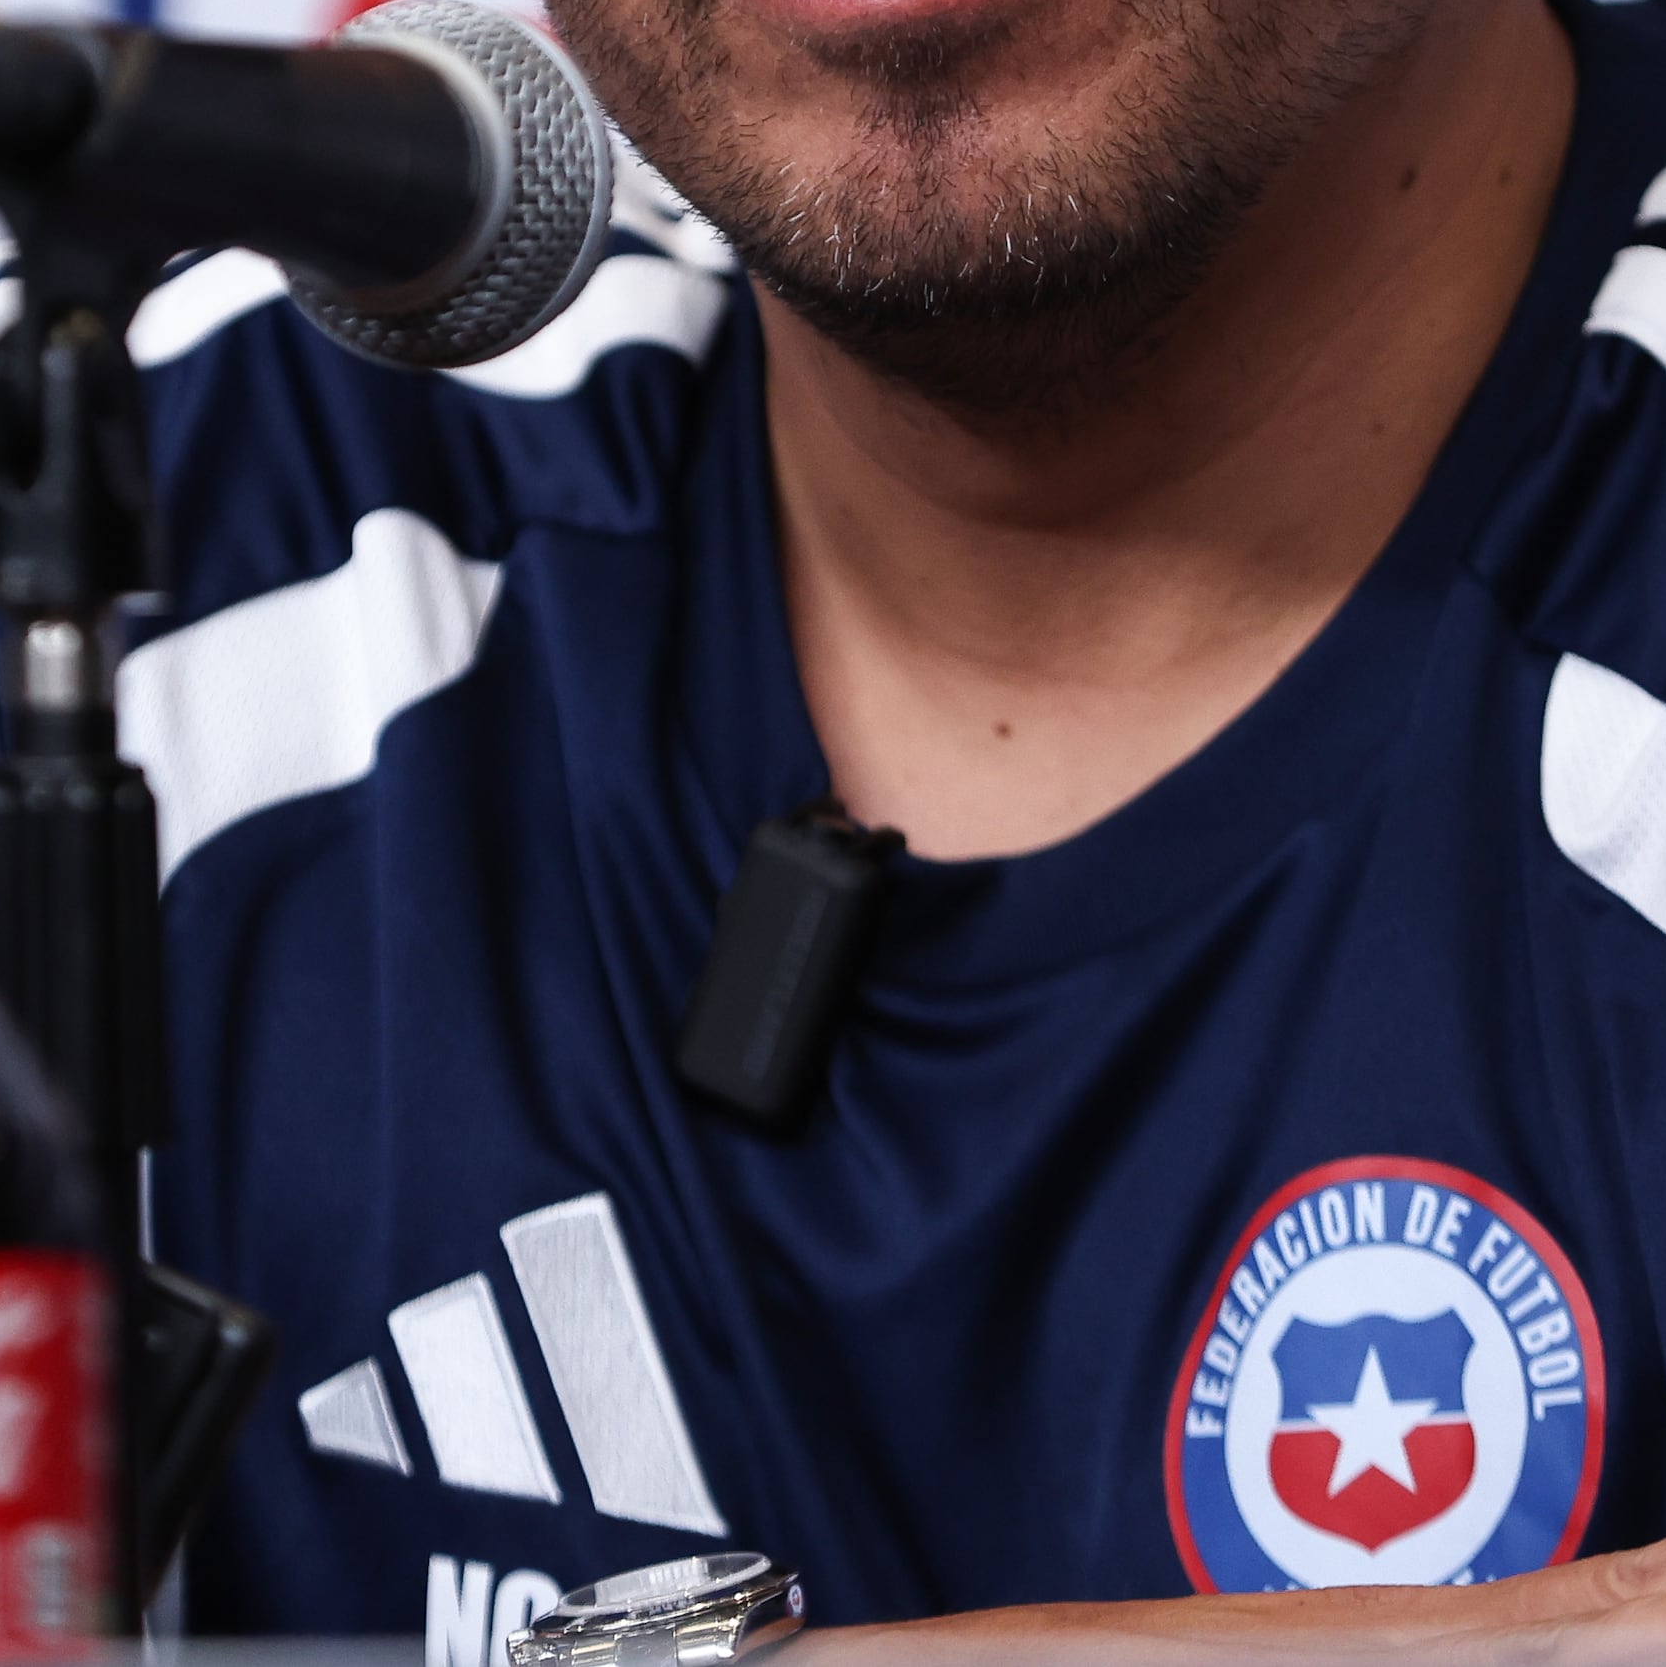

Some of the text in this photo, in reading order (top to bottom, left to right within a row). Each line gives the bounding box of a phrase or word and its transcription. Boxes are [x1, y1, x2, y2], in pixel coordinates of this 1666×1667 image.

[1188, 1181, 1584, 1438] FEDERACION DE FUTBOL
